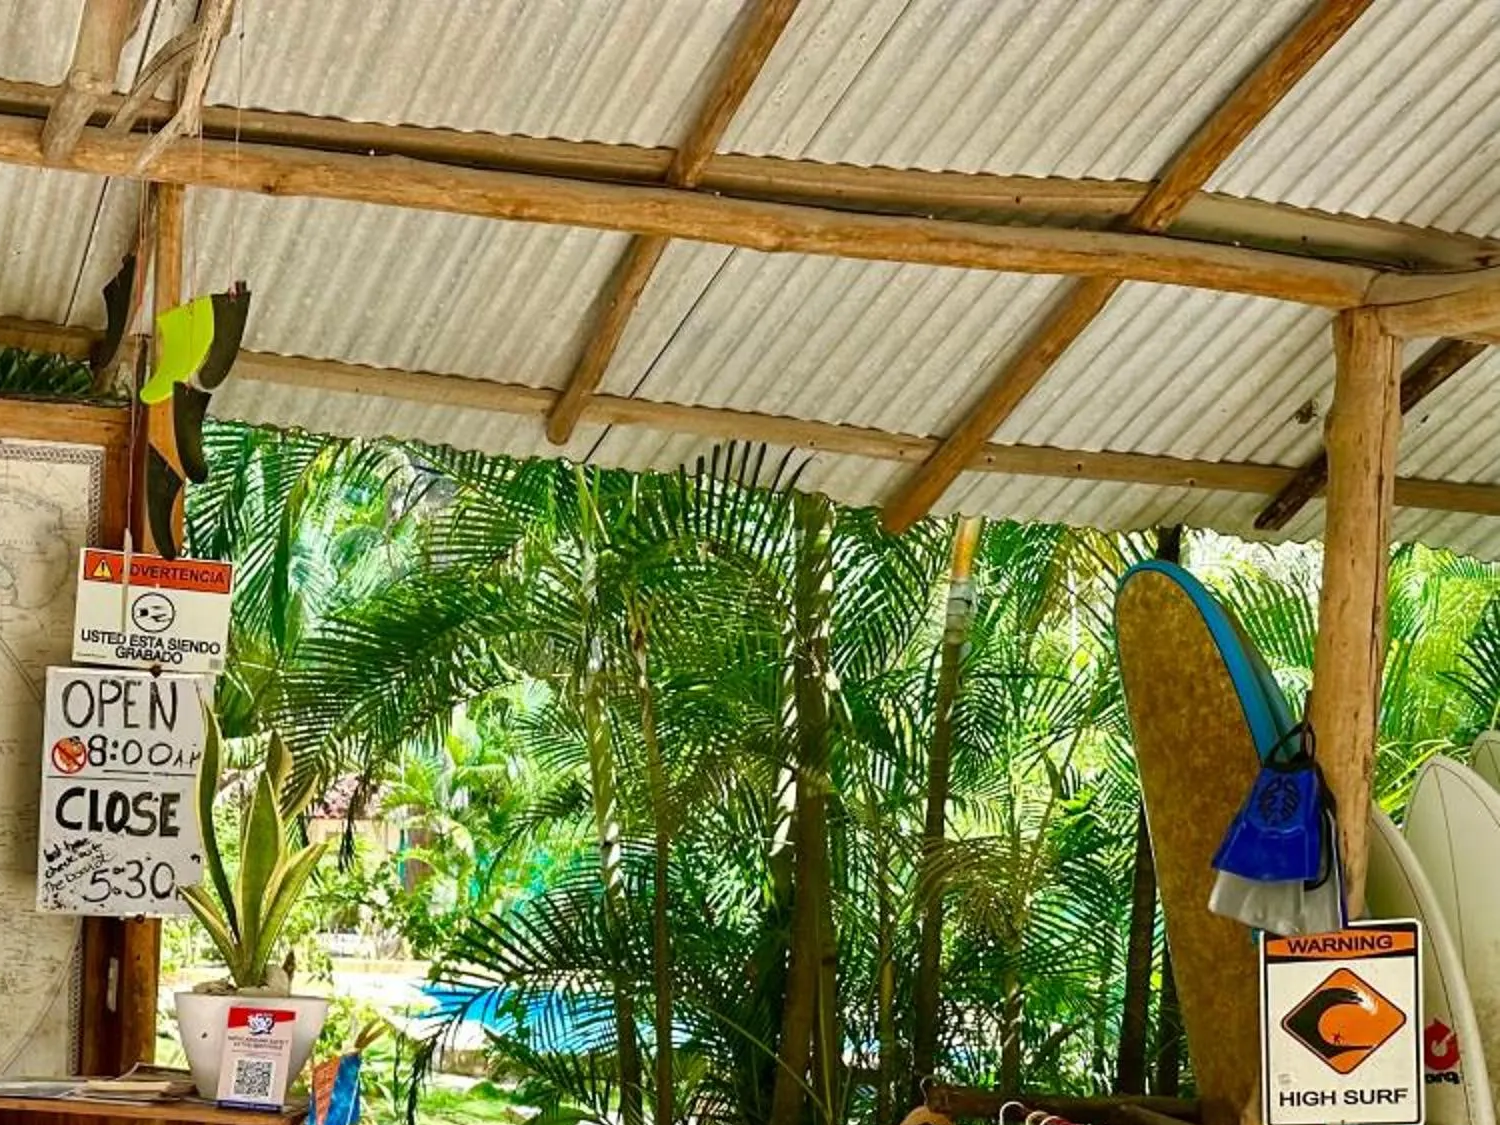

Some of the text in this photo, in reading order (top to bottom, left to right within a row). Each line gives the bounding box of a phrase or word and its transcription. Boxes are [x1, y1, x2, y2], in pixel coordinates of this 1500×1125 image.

[120, 561, 225, 584] DVERTENCIA
[81, 628, 221, 655] USTED ESTA SIENDO
[115, 646, 184, 665] GRABADO
[62, 678, 177, 731] OPEN
[87, 734, 173, 768] 8:00
[55, 787, 181, 838] CLOSE
[82, 860, 176, 903] 5:30
[1287, 934, 1393, 955] WARNING
[1424, 1071, 1461, 1085] orq
[1279, 1087, 1409, 1108] HIGH SURF
